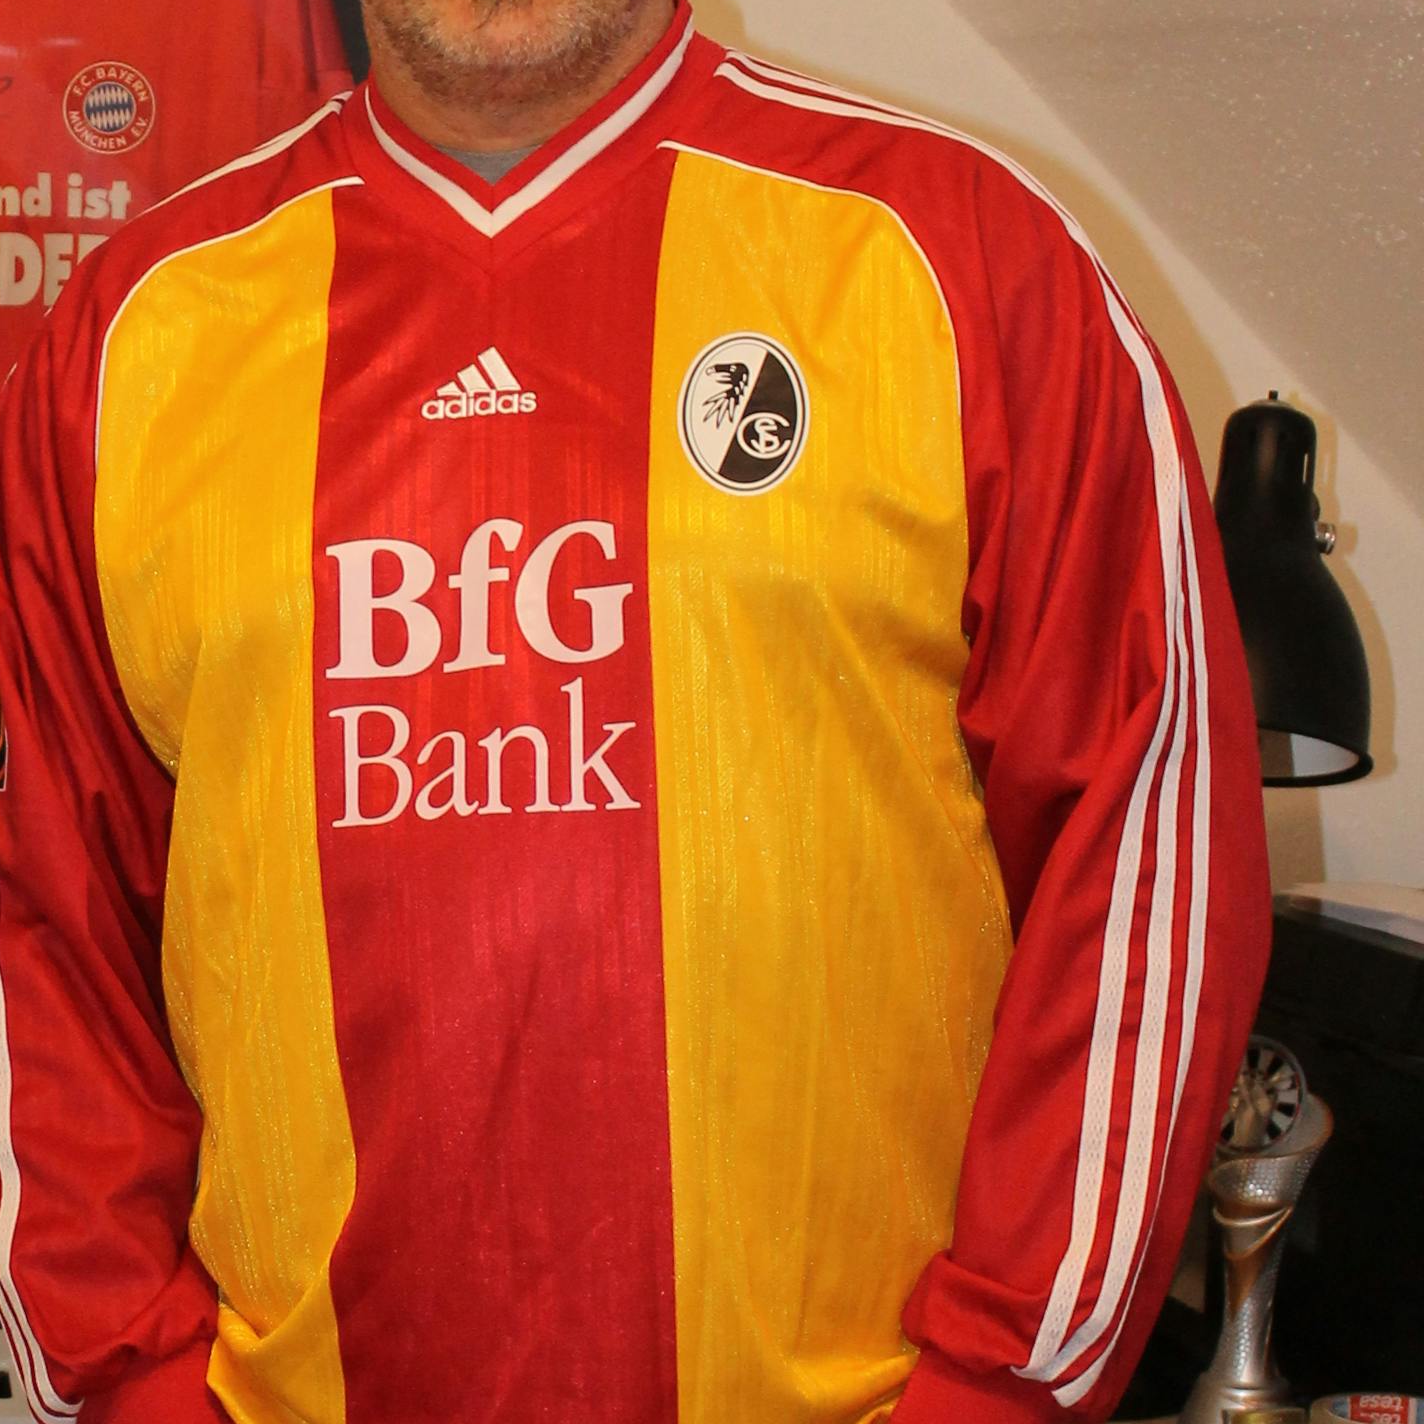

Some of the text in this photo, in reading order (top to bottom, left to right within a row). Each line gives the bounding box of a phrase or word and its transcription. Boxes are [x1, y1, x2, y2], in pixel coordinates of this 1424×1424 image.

[96, 66, 150, 103] BAYERN
[66, 173, 133, 221] ist
[420, 388, 537, 422] adidas
[324, 517, 634, 680] BfG
[327, 676, 642, 829] Bank
